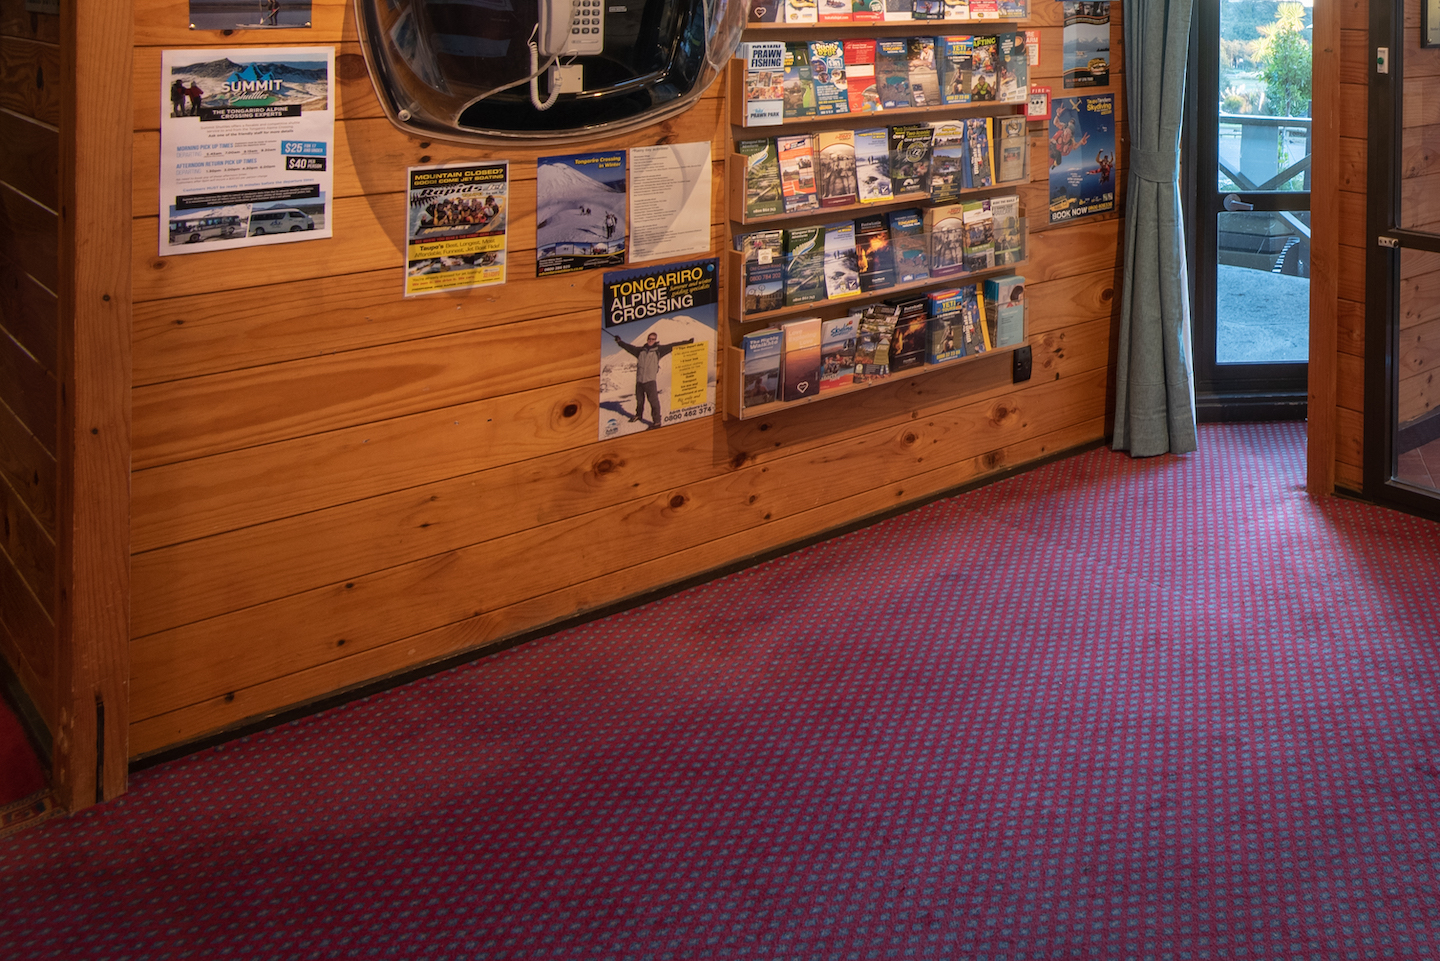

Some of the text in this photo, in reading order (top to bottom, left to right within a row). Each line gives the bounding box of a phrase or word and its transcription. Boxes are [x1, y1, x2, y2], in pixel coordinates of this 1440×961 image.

[973, 37, 996, 47] AFTING
[752, 49, 782, 59] PRAWN
[751, 58, 782, 68] FISHING
[221, 79, 283, 93] SUMMIT
[229, 90, 269, 103] Shuttles
[1087, 102, 1112, 111] Skydiving
[285, 142, 303, 154] $25
[289, 158, 307, 169] $40
[415, 169, 504, 181] MOUNTAIN CLOSED?
[420, 184, 483, 197] Rapids
[1052, 206, 1088, 220] BOOK NOW
[610, 267, 703, 298] TONGARIRO
[611, 287, 668, 312] ALPINE
[942, 300, 956, 308] YETI
[611, 294, 694, 324] CROSSING
[749, 340, 779, 350] Waikato
[664, 406, 713, 422] 0800 462 374
